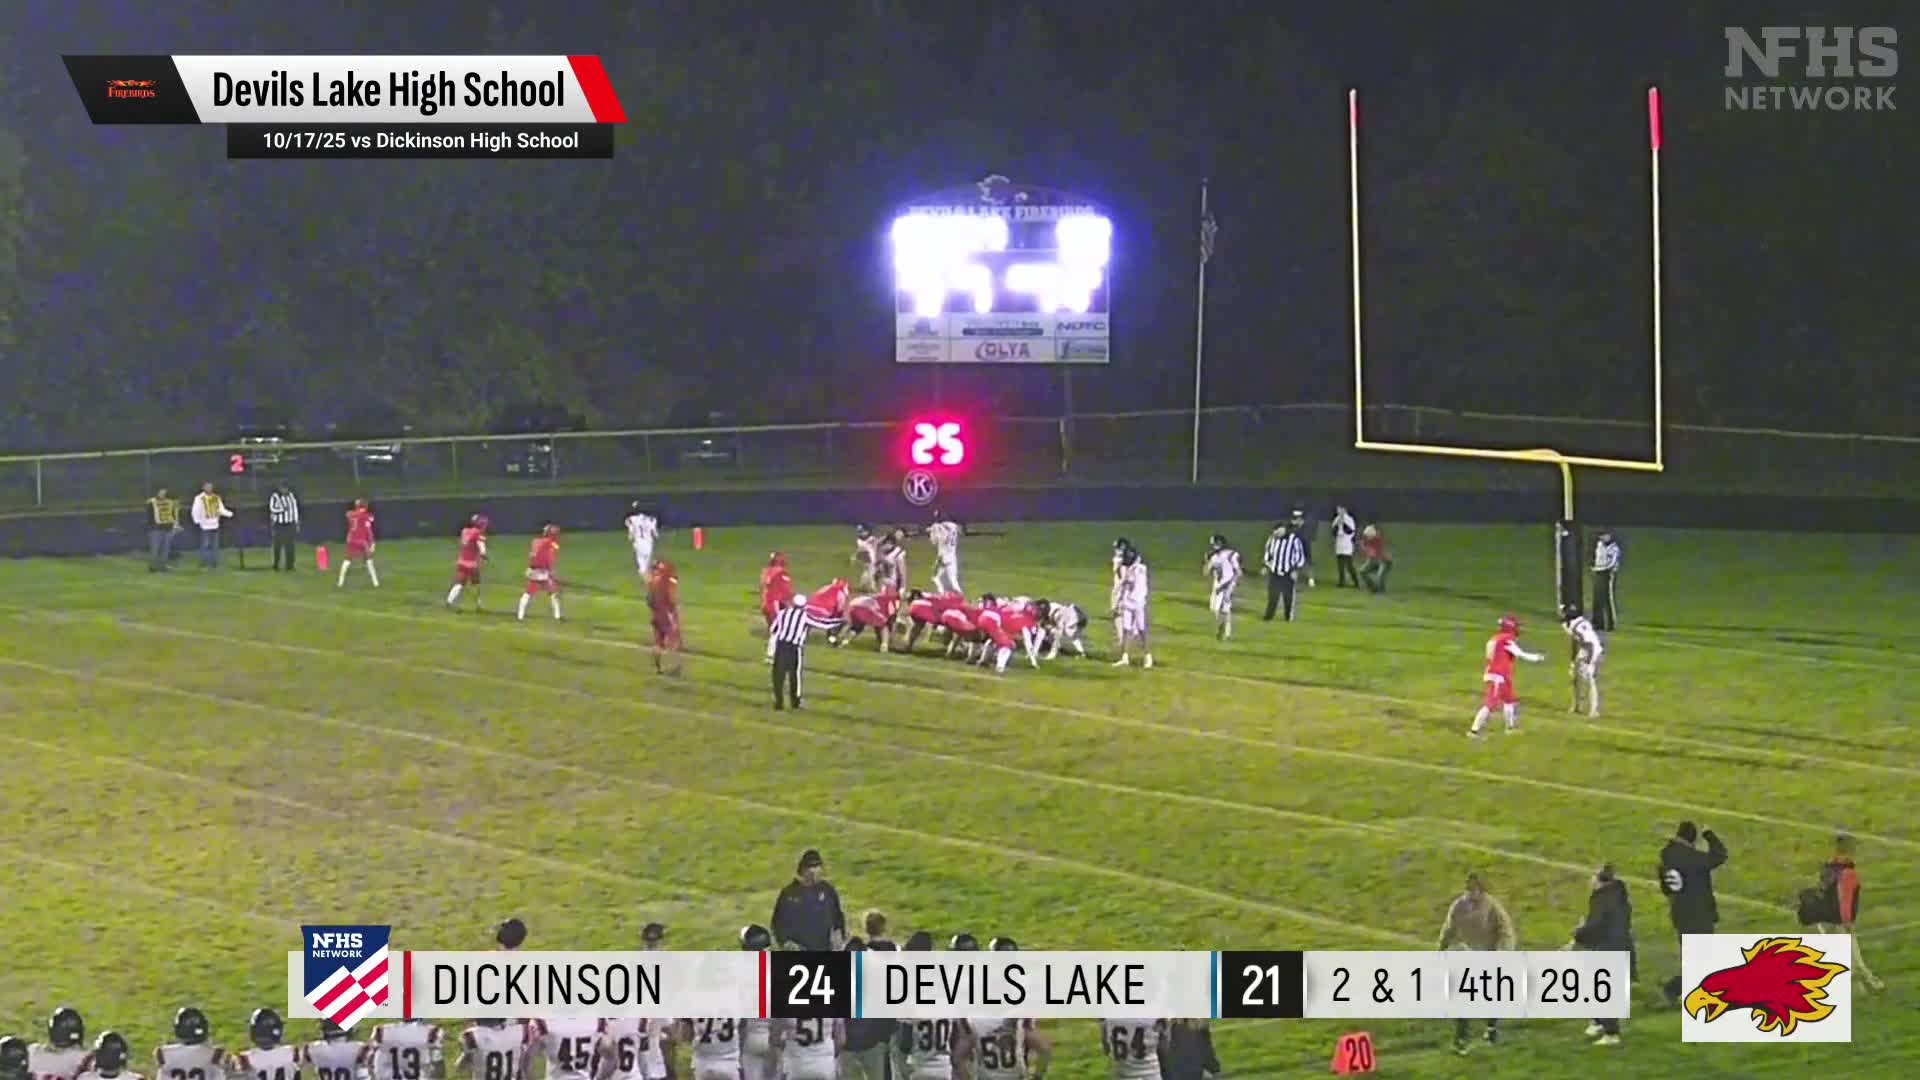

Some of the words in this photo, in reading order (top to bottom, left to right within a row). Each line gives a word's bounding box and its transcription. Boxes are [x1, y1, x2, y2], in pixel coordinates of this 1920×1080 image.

[911, 422, 964, 465] 25
[230, 454, 244, 472] 2
[917, 1018, 949, 1051] 30
[980, 1034, 1016, 1069] 50
[1111, 1026, 1146, 1060] 64
[389, 1047, 420, 1080] 13
[487, 1050, 513, 1080] 81
[557, 1036, 592, 1071] 45
[1345, 1036, 1372, 1071] 20
